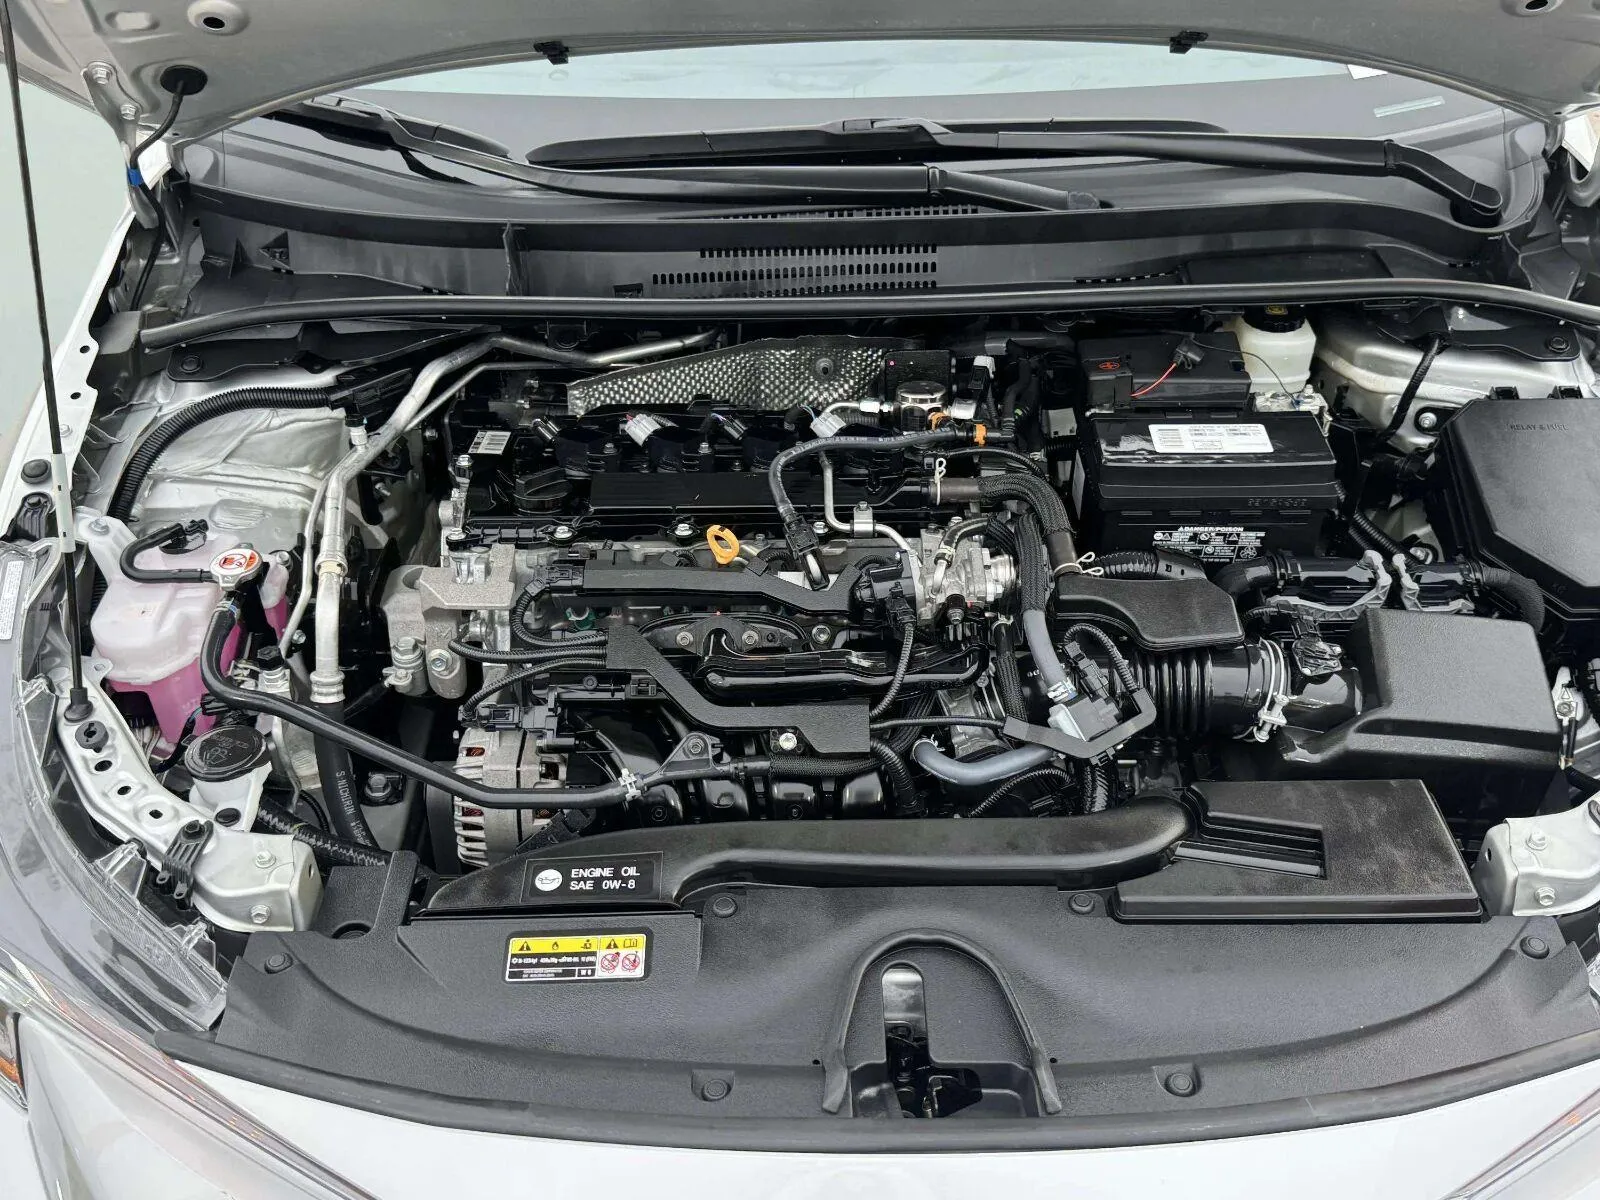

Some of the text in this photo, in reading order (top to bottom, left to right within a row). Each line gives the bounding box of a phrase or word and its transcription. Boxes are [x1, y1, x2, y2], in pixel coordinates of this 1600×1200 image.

[571, 866, 641, 878] ENGINE OIL
[569, 879, 636, 891] SAE 0W-8
